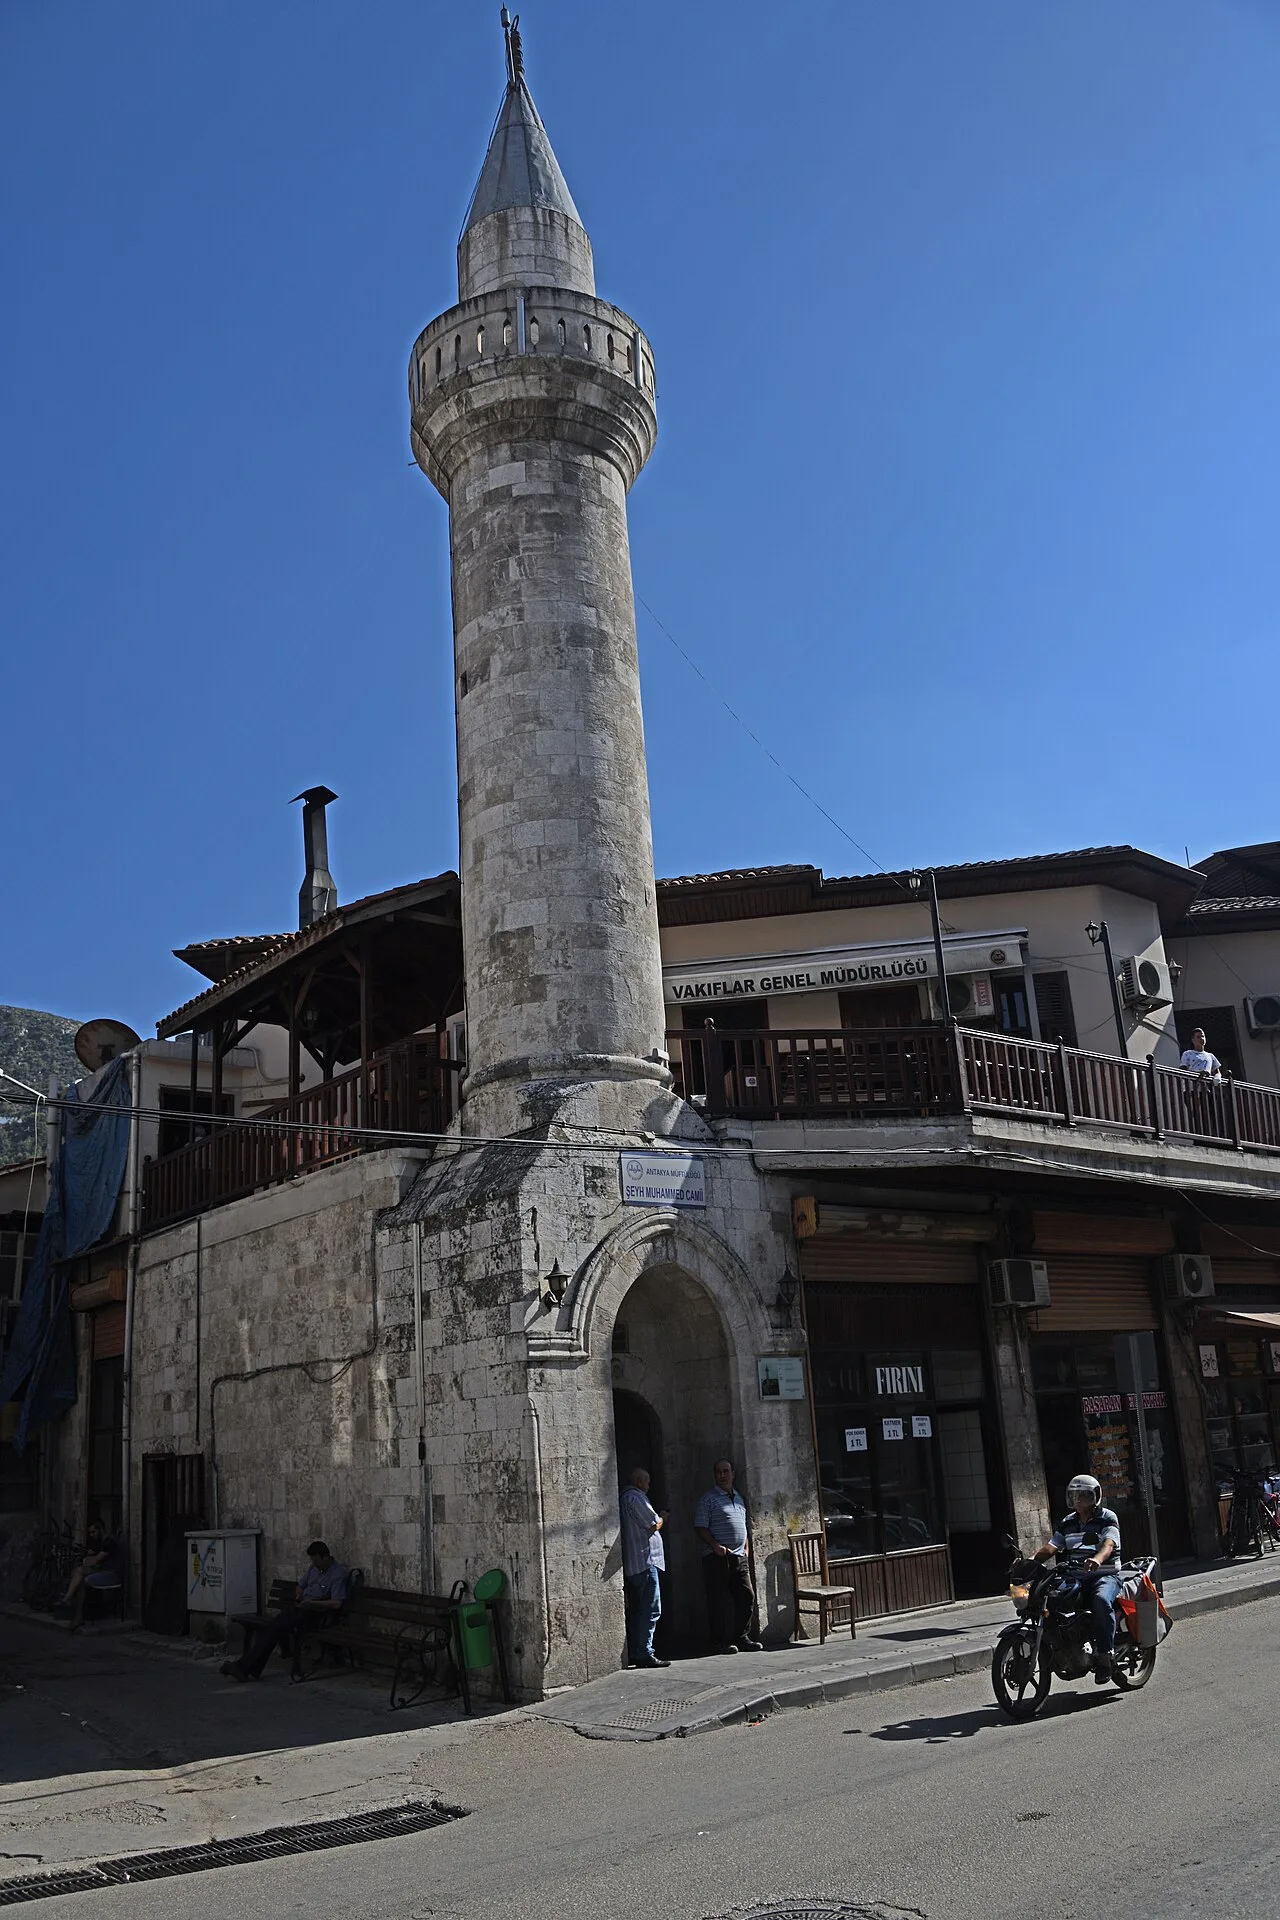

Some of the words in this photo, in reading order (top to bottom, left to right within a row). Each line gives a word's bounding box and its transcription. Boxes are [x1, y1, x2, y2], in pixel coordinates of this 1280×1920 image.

[672, 979, 755, 999] VAKIFLAR
[760, 973, 816, 991] GENEL
[820, 958, 928, 985] MÜDÜRLÜĞÜ
[646, 1168, 670, 1177] ANTAKYA
[670, 1169, 701, 1179] MÜFTÜLÜĞÜ
[626, 1185, 644, 1199] ŞEYH
[645, 1187, 685, 1200] MUHAMMED
[875, 1366, 924, 1395] FIRINI
[887, 1429, 892, 1438] 1
[892, 1429, 900, 1437] TL
[850, 1439, 855, 1447] 1
[855, 1439, 863, 1447] TL
